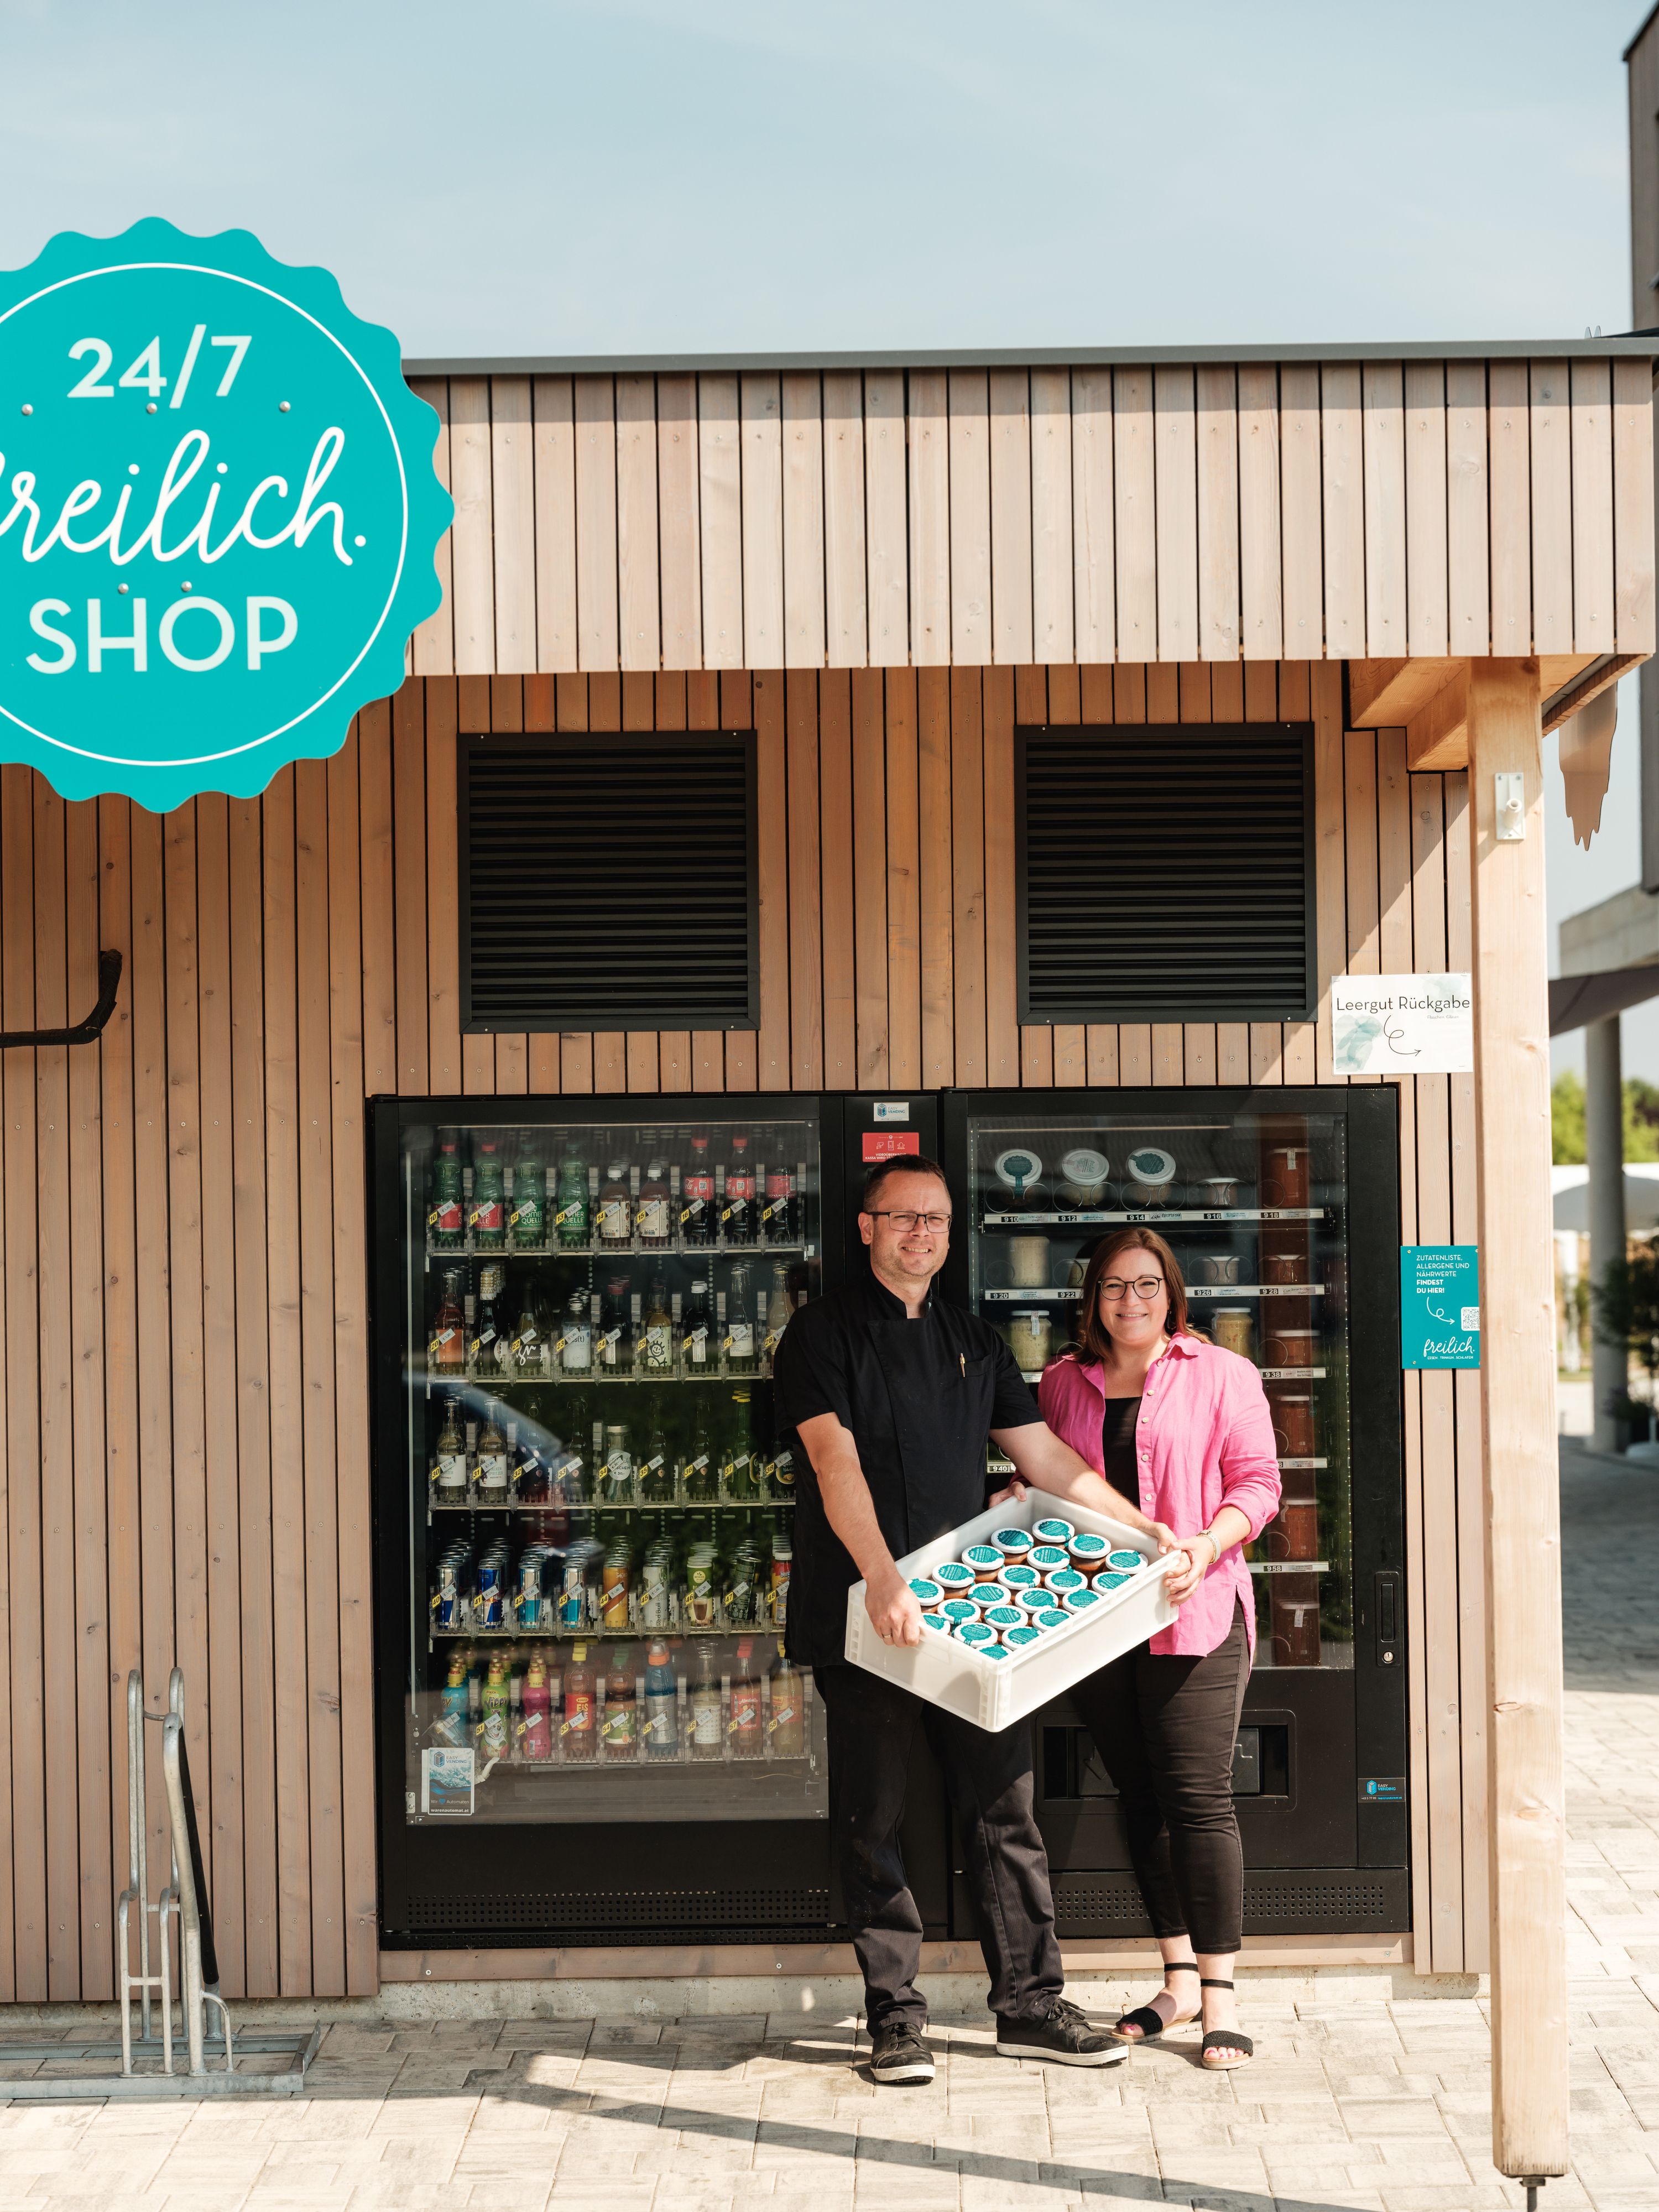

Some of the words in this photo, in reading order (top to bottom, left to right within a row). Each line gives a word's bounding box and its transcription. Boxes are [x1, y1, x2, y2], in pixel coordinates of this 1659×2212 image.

[67, 324, 252, 409] 24/7
[25, 596, 299, 674] SHOP
[1337, 997, 1394, 1014] Leergut
[1399, 995, 1470, 1013] Rückgabe
[724, 1338, 731, 1347] 27
[640, 1467, 647, 1476] 35
[685, 1467, 692, 1475] 36
[726, 1466, 732, 1474] 37
[766, 1465, 773, 1473] 38
[560, 1597, 567, 1605] 43
[641, 1595, 648, 1603] 45
[726, 1595, 732, 1603] 47
[644, 1724, 651, 1732] 55
[688, 1722, 695, 1731] 56
[729, 1721, 737, 1730] 57
[770, 1720, 776, 1729] 58
[561, 1725, 568, 1733] 53
